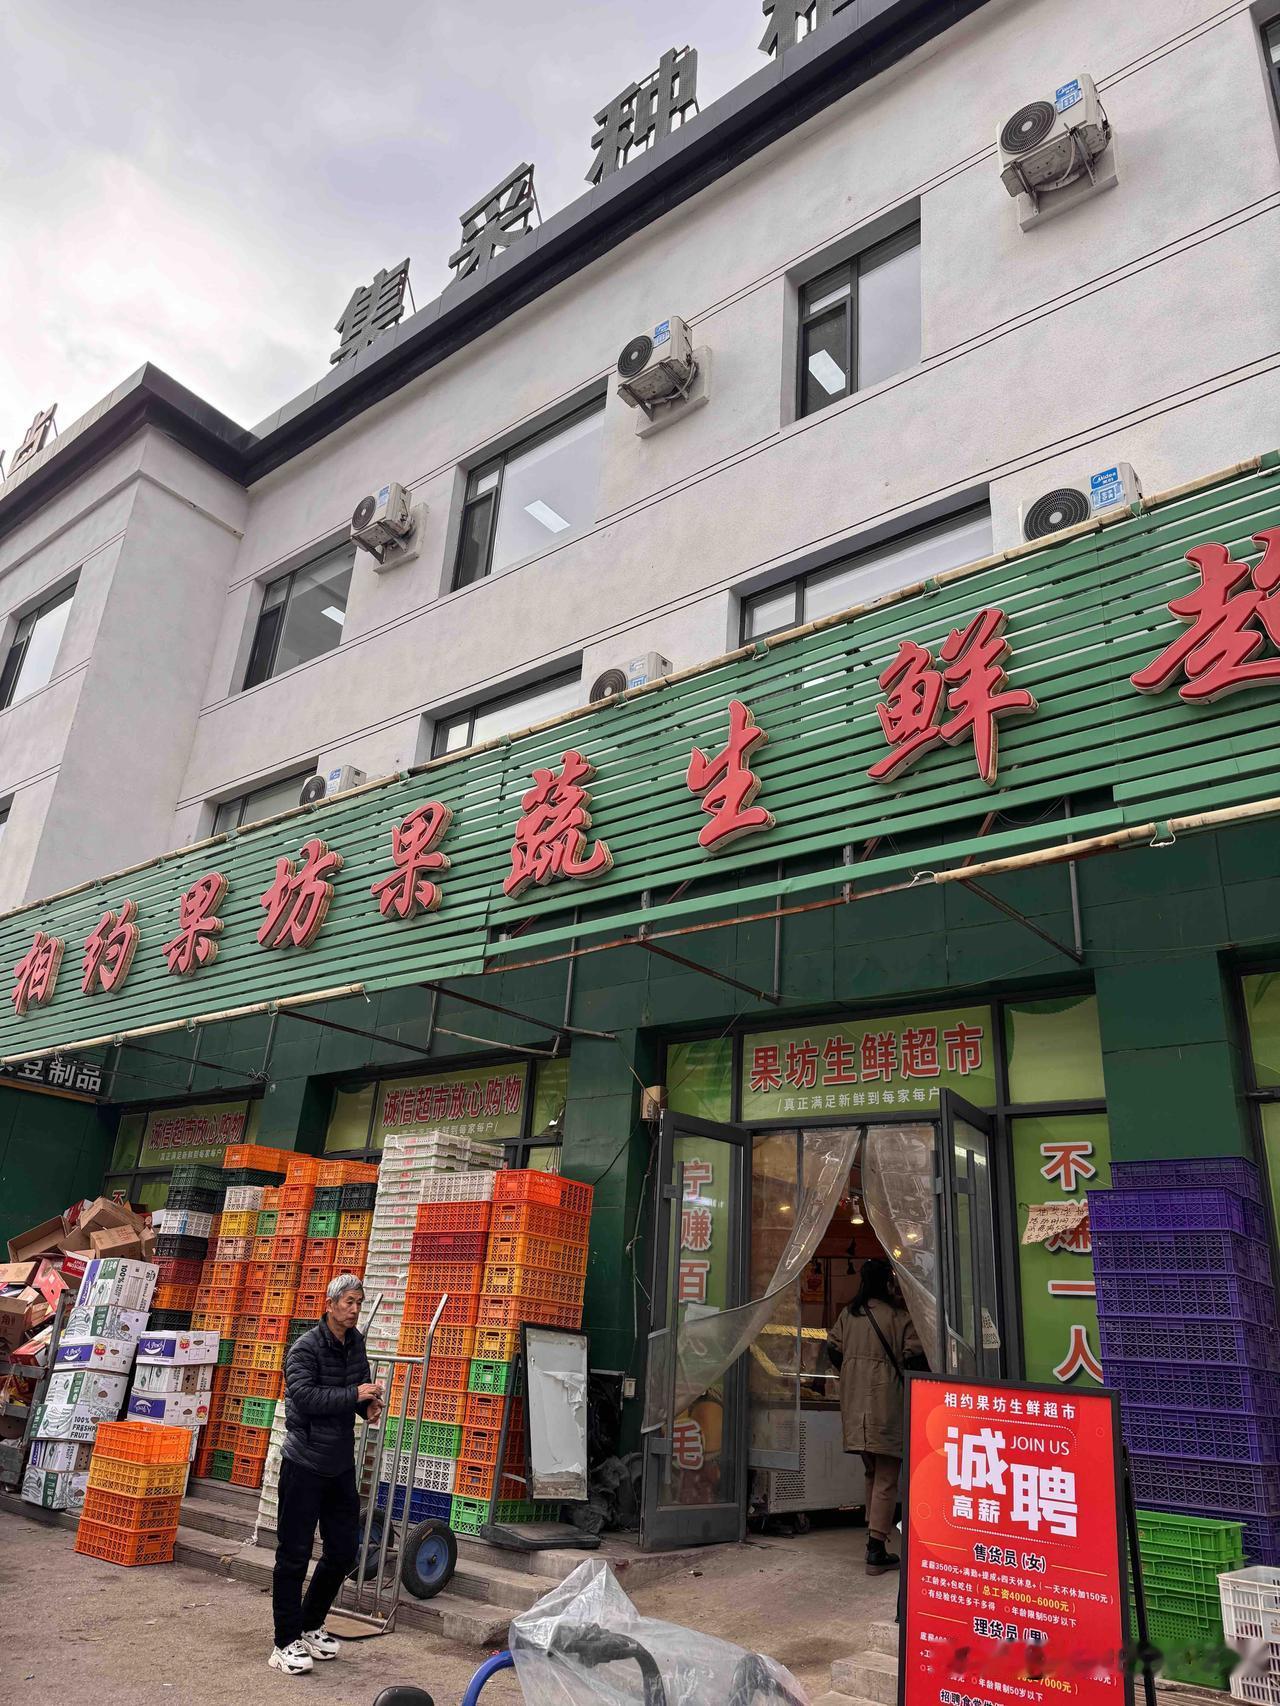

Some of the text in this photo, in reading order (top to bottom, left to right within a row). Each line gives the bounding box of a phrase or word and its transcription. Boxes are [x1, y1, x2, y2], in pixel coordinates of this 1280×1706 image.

[749, 1021, 984, 1093] 果坊生鲜超市
[0, 1060, 102, 1092] 豆制品
[382, 1073, 523, 1127] 诚信超市放心购物
[74, 1416, 90, 1424] 100%
[944, 1391, 1076, 1420] 相约果坊生鲜超市
[70, 1431, 89, 1439] FRUIT
[1011, 1436, 1070, 1456] JOIN US
[952, 1494, 1001, 1524] 高薪
[928, 1588, 1077, 1628] 有经验优先多干多得 年龄限制50岁以下
[978, 1677, 1043, 1702] 年龄限制50岁以下
